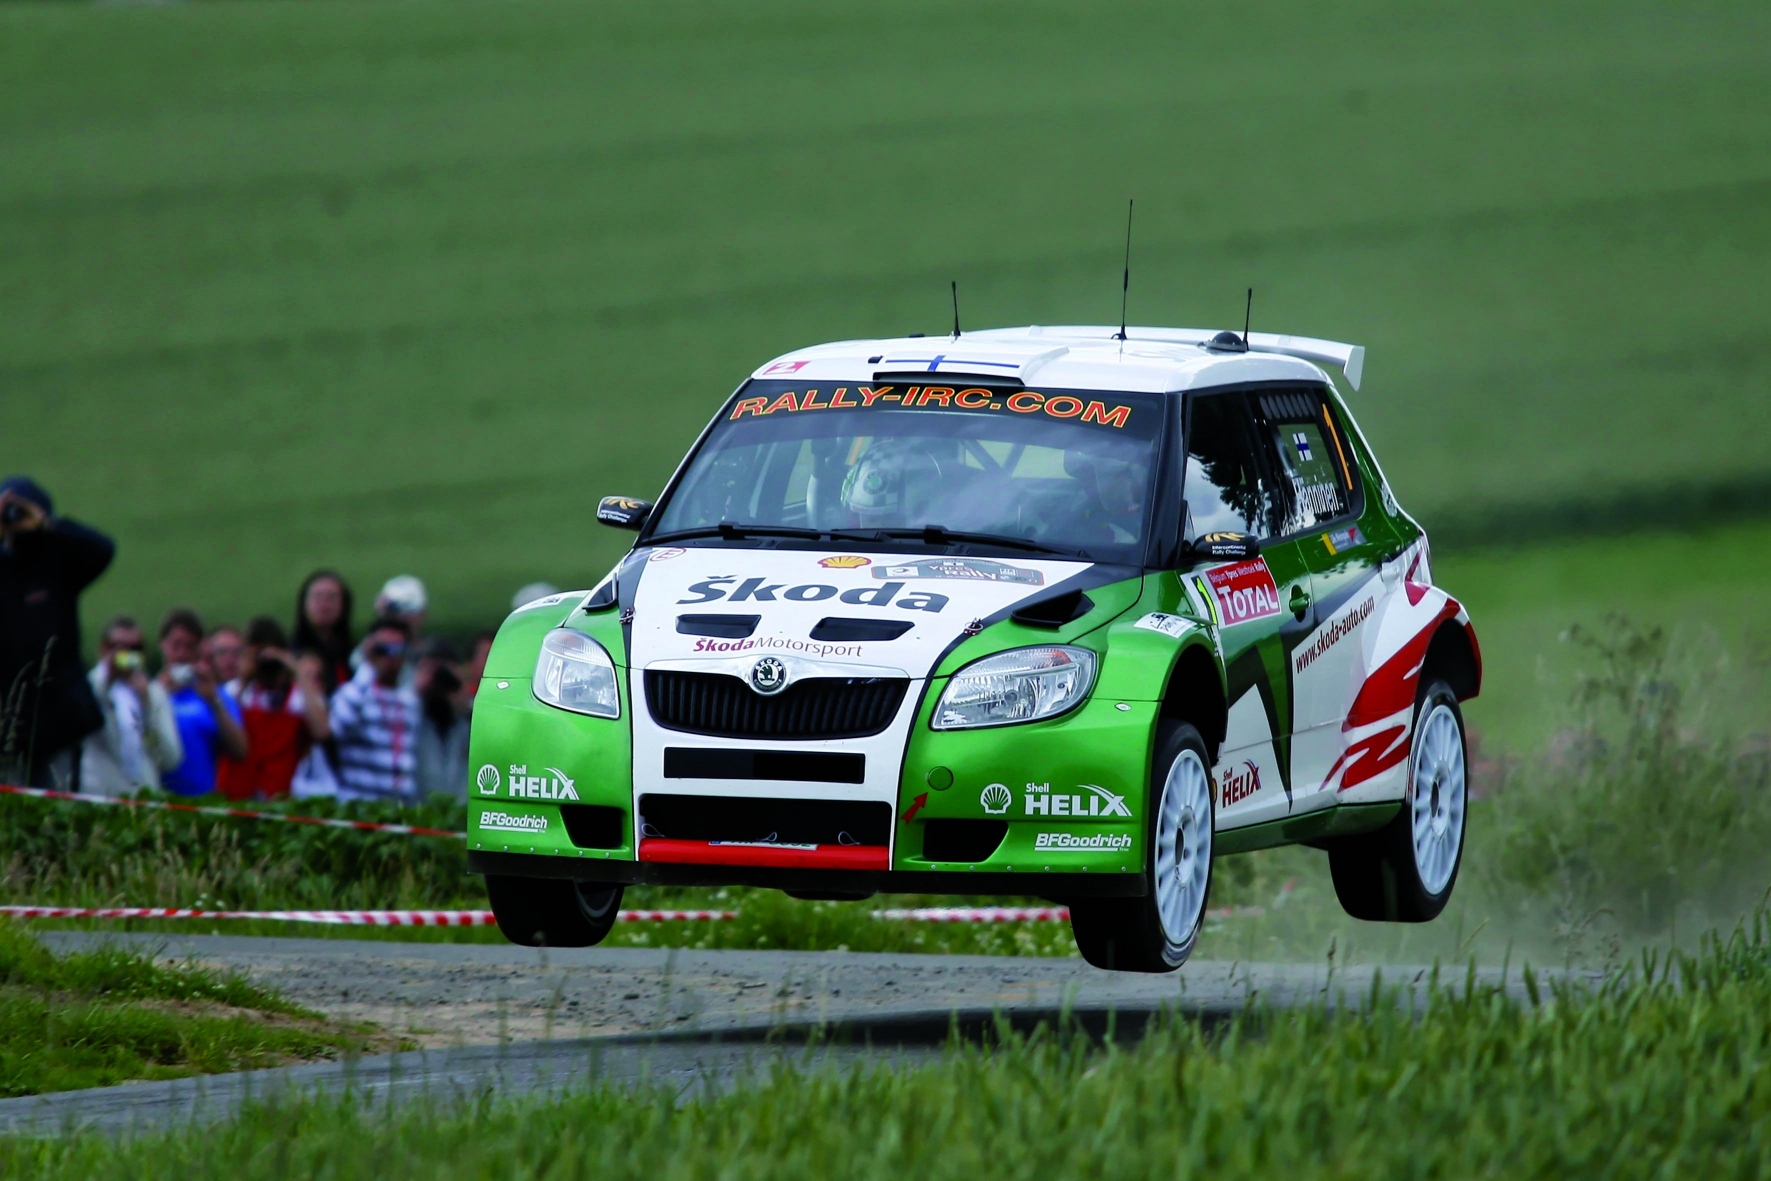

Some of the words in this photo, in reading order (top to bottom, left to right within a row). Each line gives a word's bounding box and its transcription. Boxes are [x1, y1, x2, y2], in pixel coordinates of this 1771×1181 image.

[730, 386, 1131, 428] RALLY-IRC.COM
[1217, 583, 1279, 620] TOTAL
[1295, 595, 1375, 674] www.skoda-auto.com
[510, 764, 527, 775] Shell
[508, 770, 580, 800] HELIX
[1025, 782, 1050, 793] Shell
[1222, 763, 1262, 808] HELIX
[1024, 788, 1133, 817] HELIX
[480, 811, 548, 829] BFGoodrich
[1035, 833, 1132, 847] BFGoodrich
